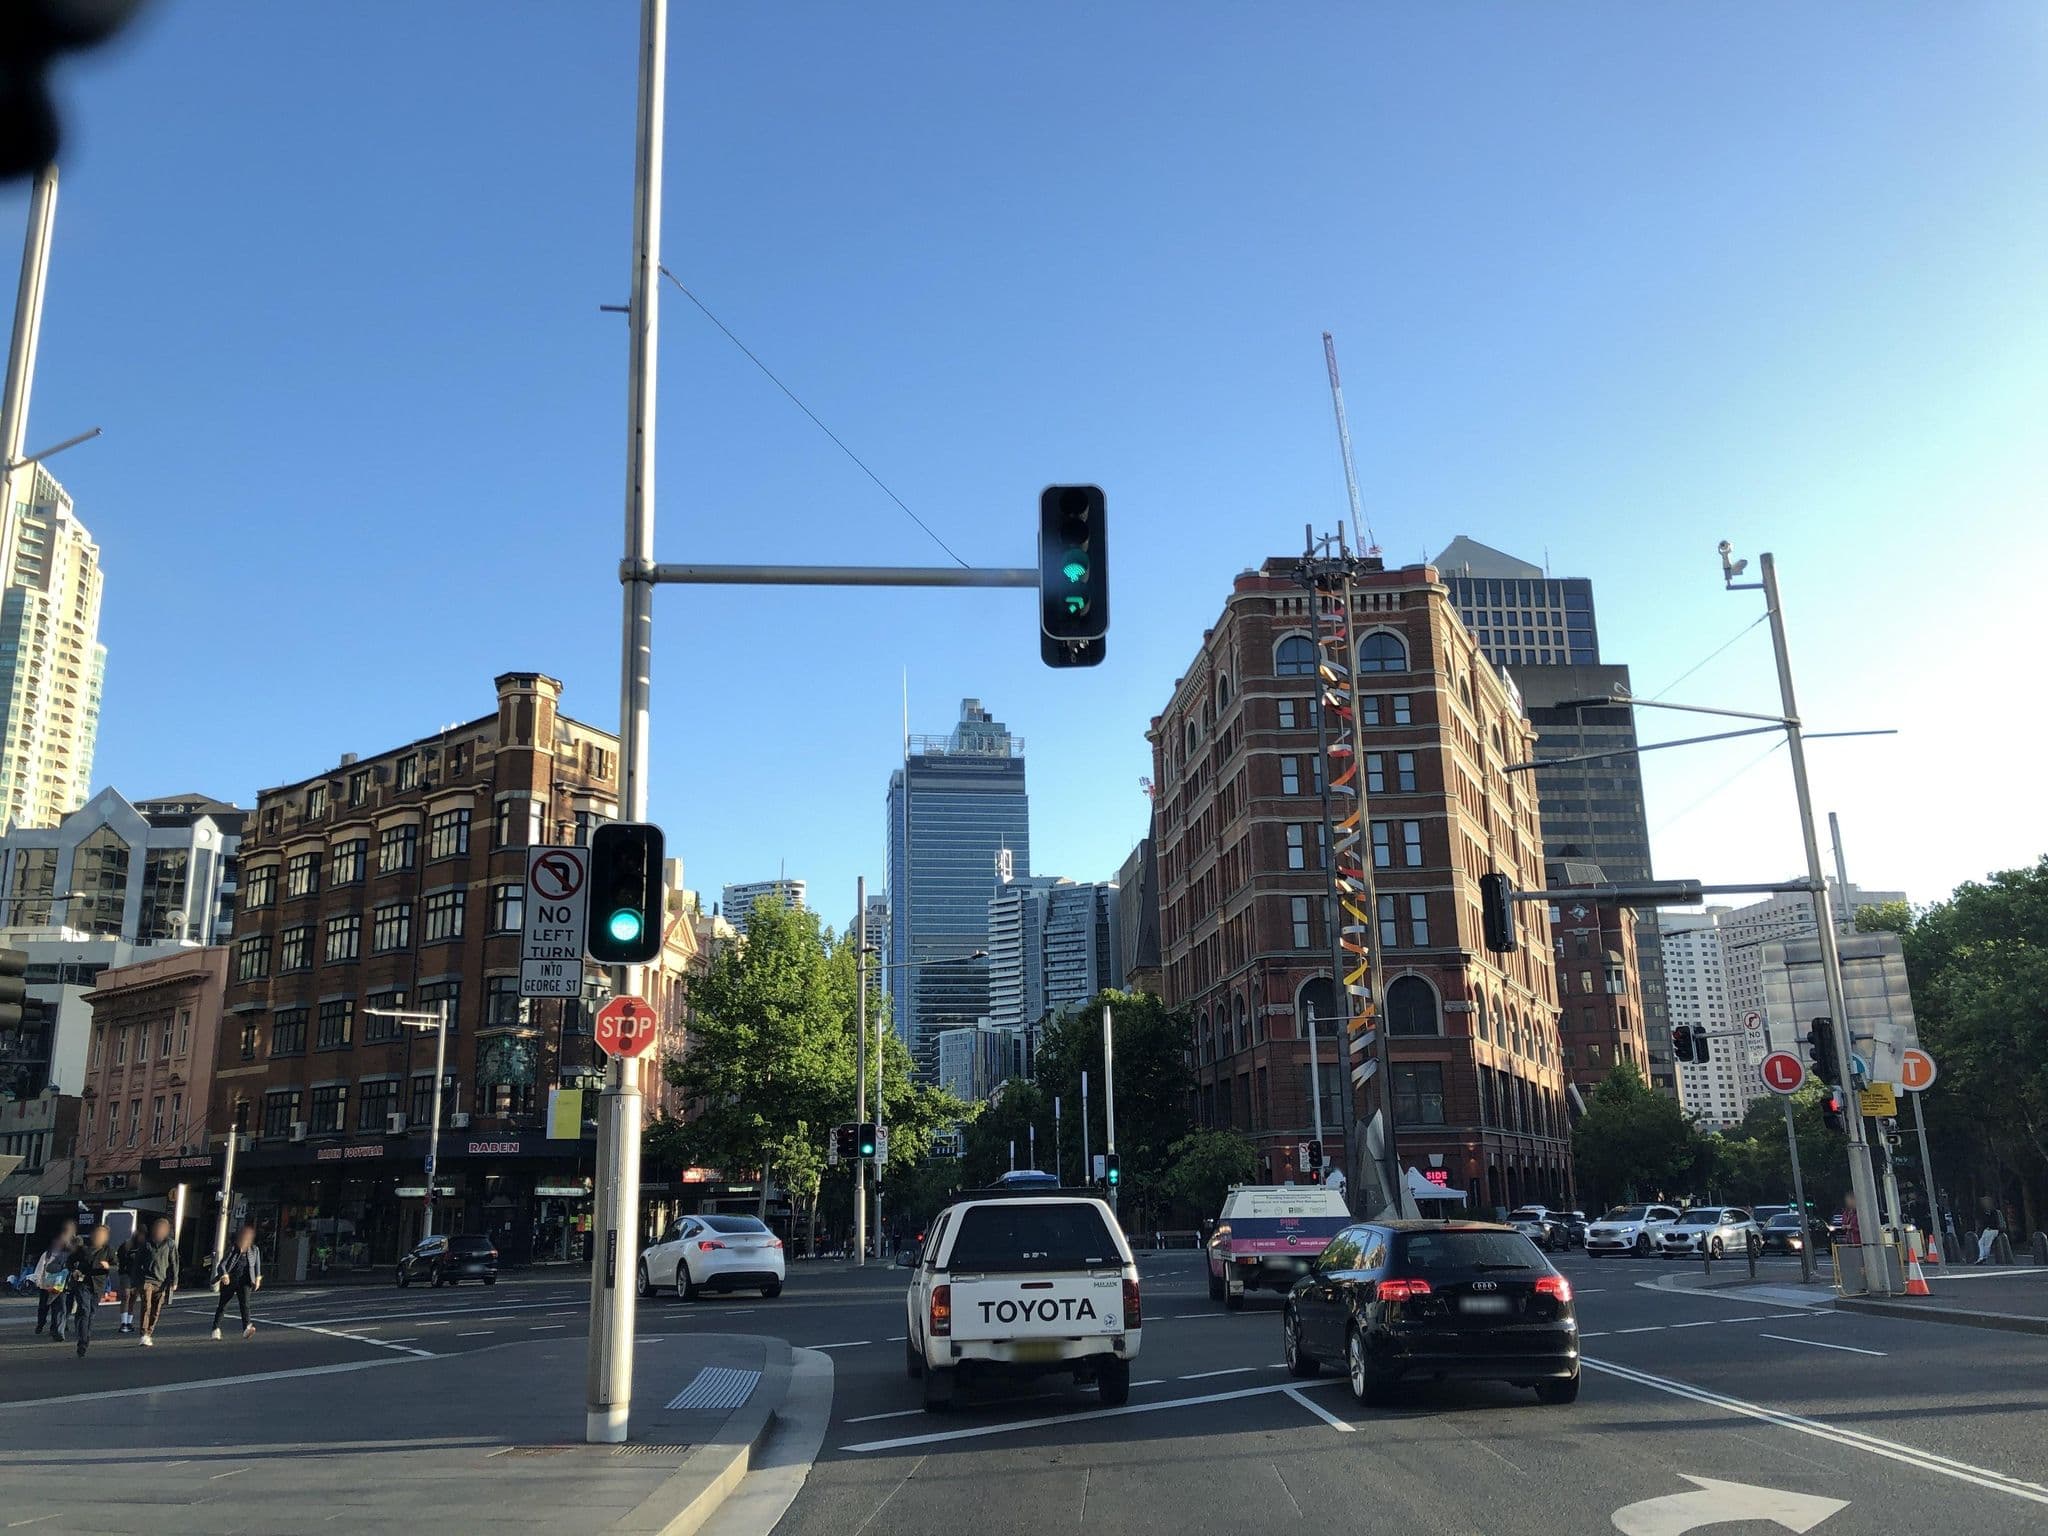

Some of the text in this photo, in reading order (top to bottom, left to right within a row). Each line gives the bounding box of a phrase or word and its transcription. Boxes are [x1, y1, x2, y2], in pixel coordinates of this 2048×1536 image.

[538, 906, 571, 924] NO
[533, 929, 574, 941] LEFT
[531, 946, 575, 958] TURN
[541, 964, 563, 977] INTO
[524, 980, 577, 992] GEORGE ST
[601, 1016, 652, 1038] STOP
[1749, 1031, 1761, 1039] NO
[1775, 1060, 1793, 1083] L
[1904, 1059, 1921, 1081] T
[468, 1142, 520, 1153] RABEN
[1426, 1171, 1448, 1180] SIDE
[978, 1298, 1097, 1323] TOYOTA
